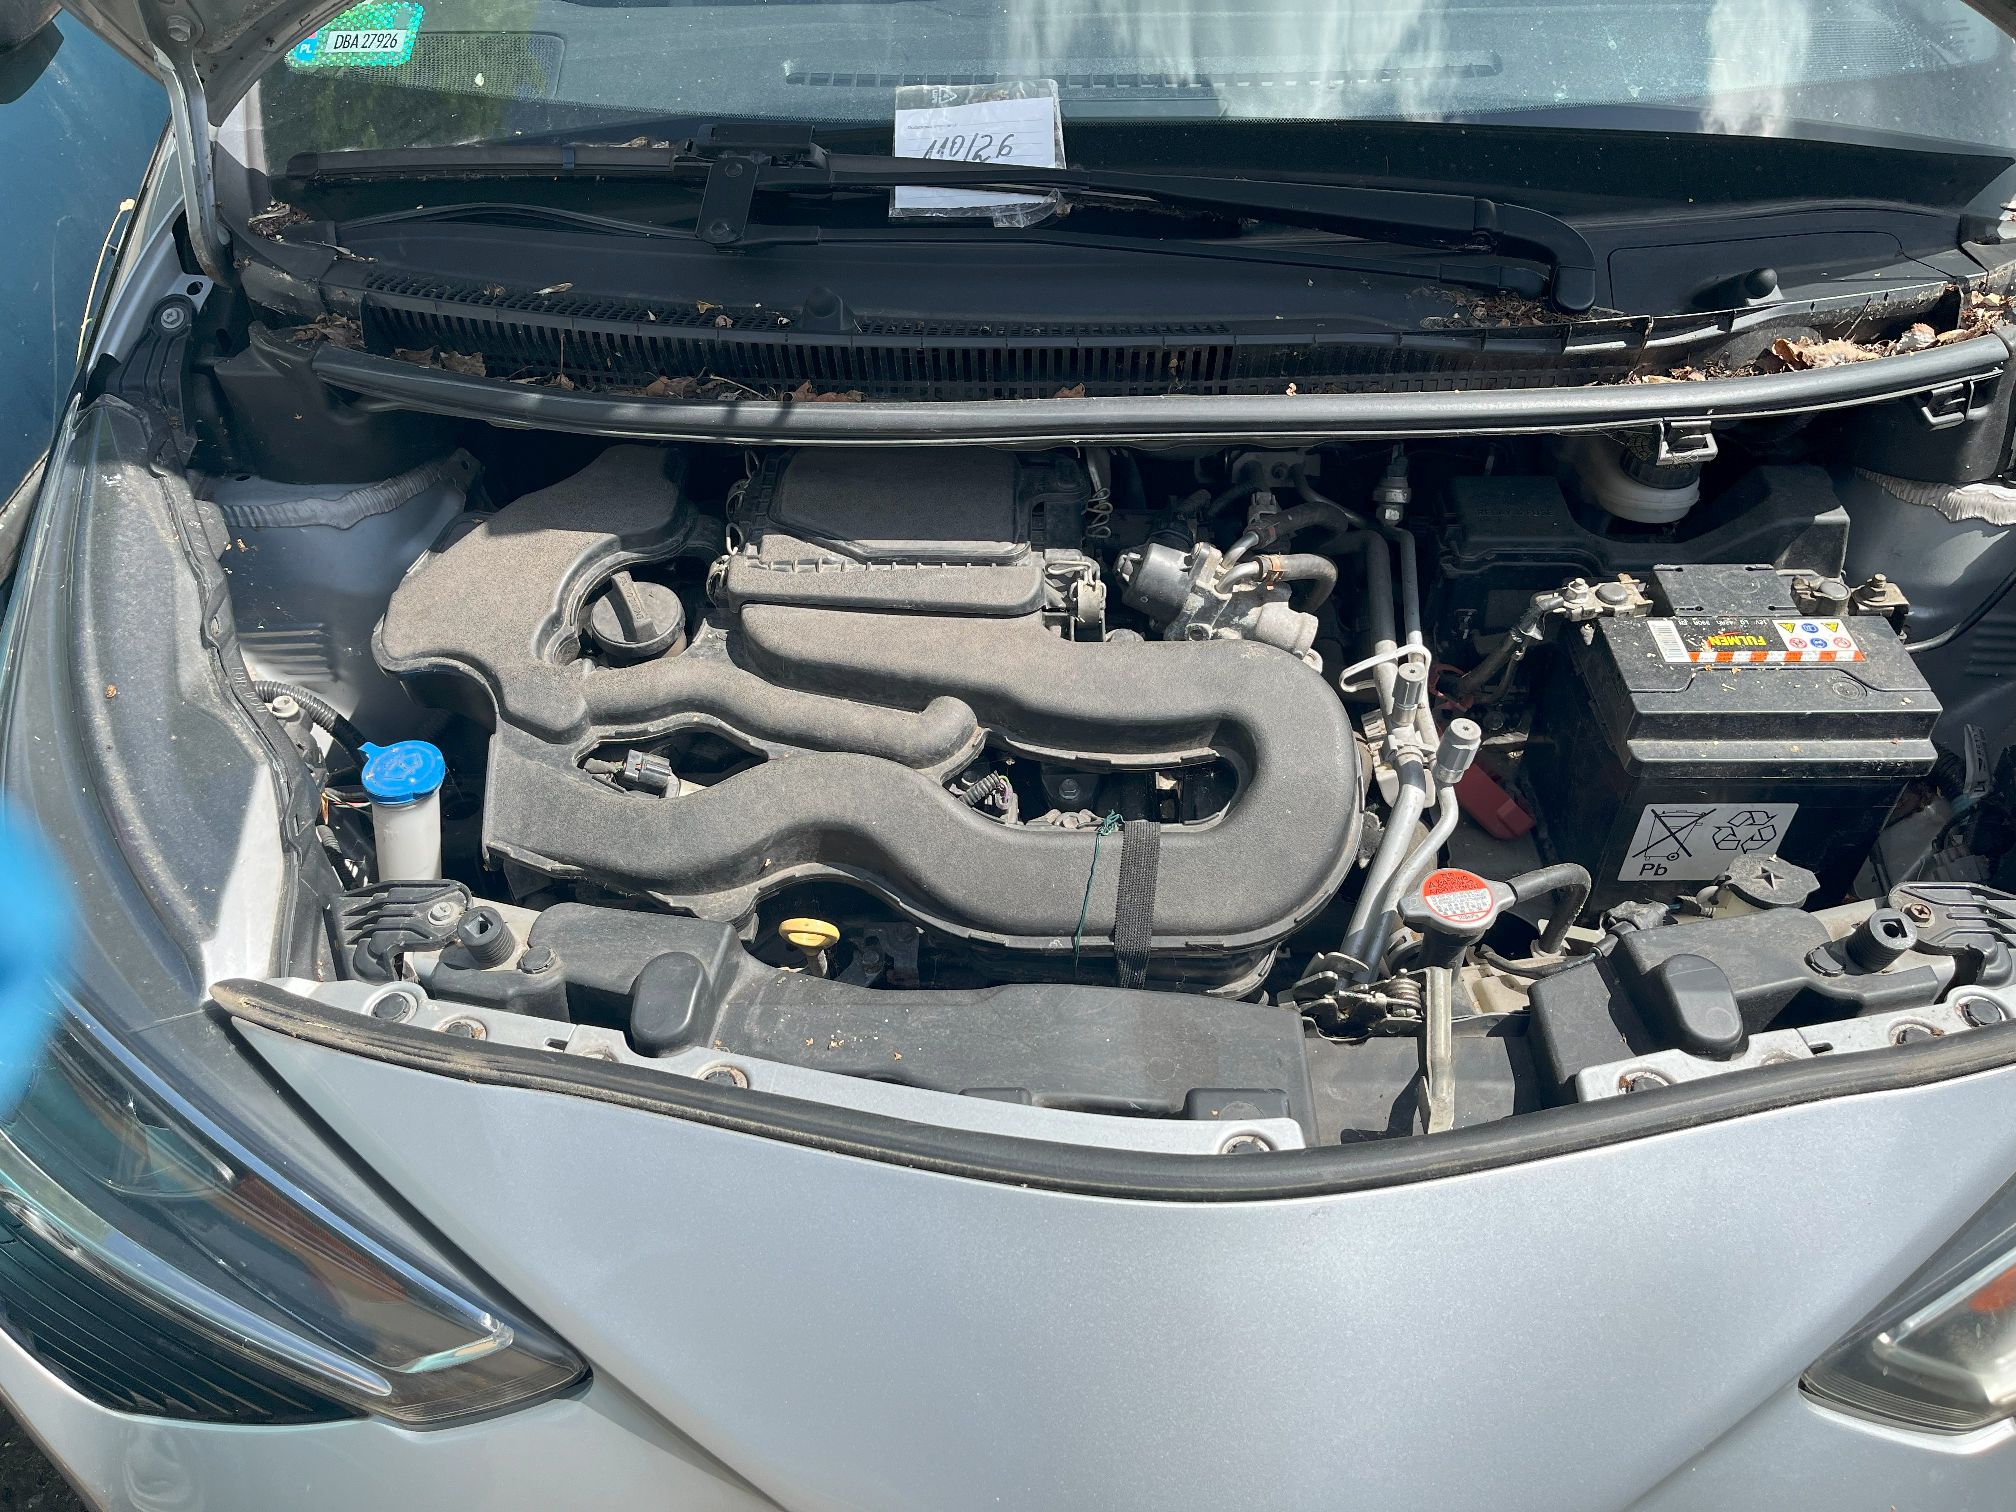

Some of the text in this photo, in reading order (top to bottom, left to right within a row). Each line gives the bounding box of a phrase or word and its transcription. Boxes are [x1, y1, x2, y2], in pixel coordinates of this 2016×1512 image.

[334, 33, 398, 49] DBA 27926
[300, 43, 312, 53] PL
[1708, 636, 1766, 646] FULMEN
[1639, 863, 1668, 876] Pb
